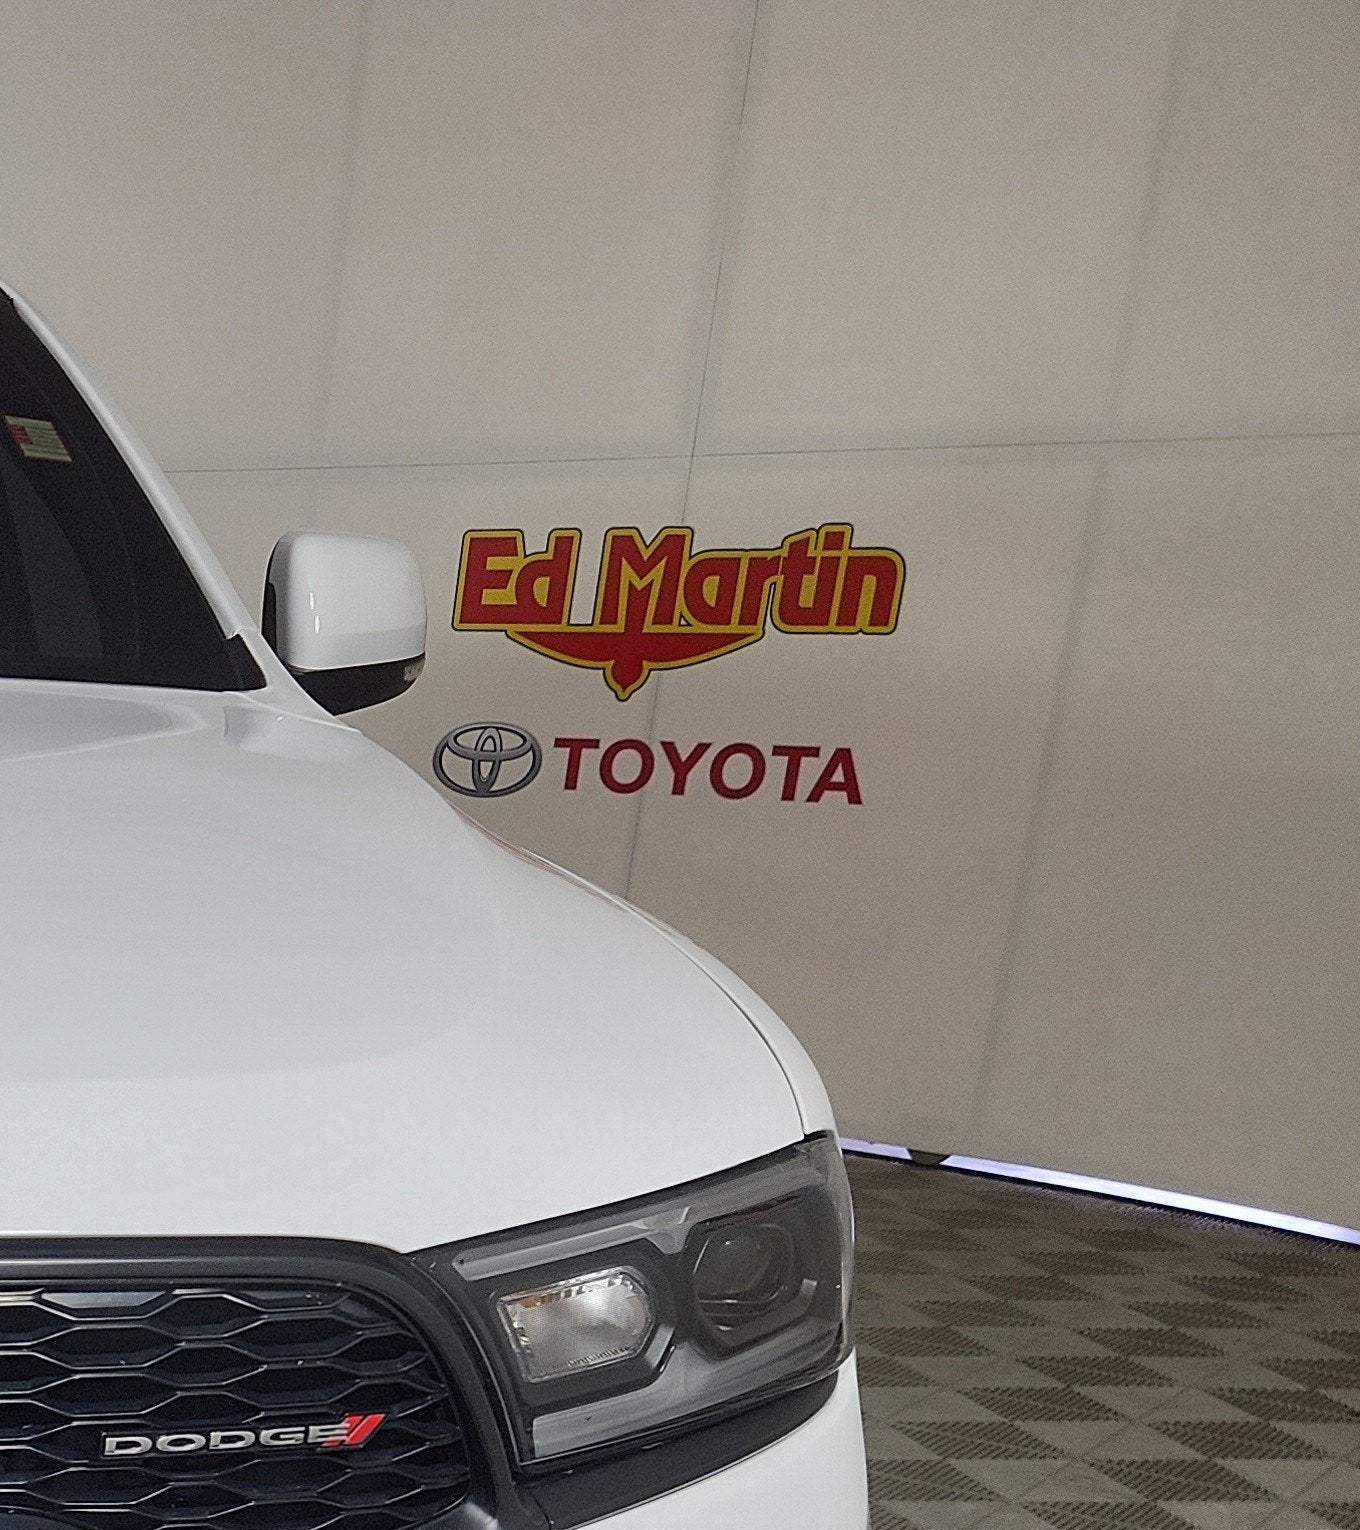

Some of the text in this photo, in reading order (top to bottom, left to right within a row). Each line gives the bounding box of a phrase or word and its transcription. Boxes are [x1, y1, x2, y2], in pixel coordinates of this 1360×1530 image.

[452, 523, 906, 634] Ed Martin
[553, 737, 863, 805] TOYOTA
[103, 1421, 350, 1456] DODGE
